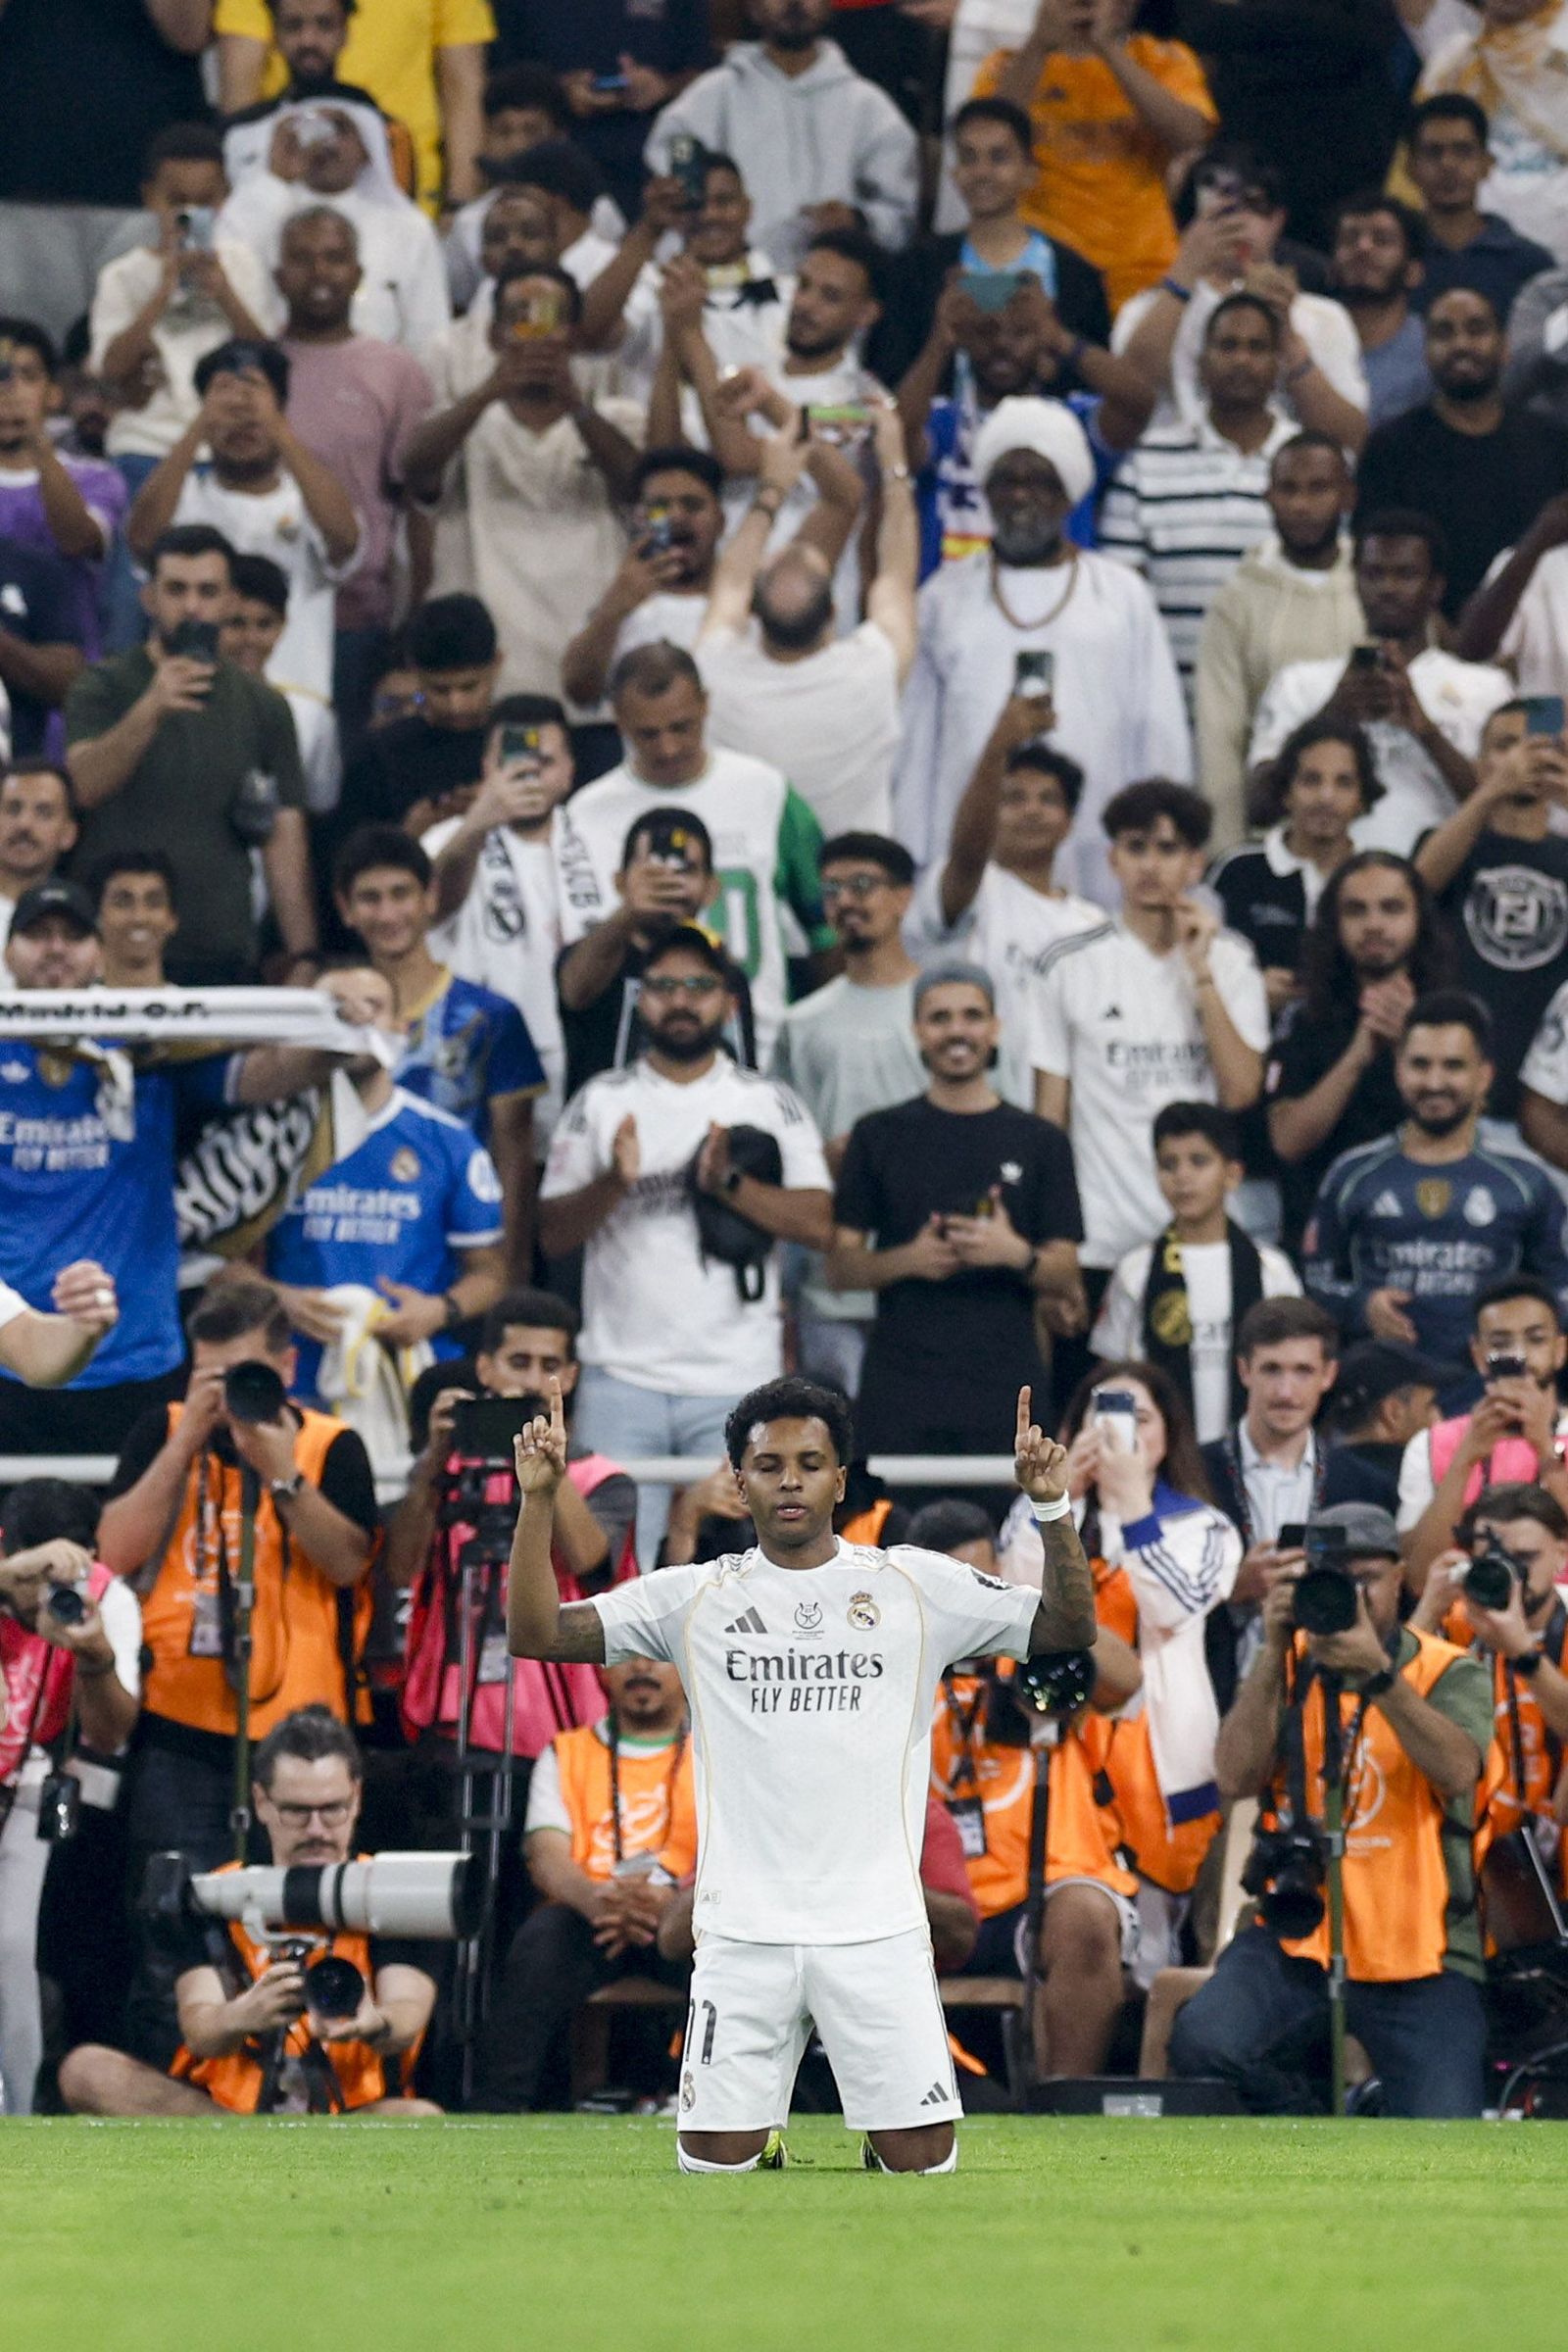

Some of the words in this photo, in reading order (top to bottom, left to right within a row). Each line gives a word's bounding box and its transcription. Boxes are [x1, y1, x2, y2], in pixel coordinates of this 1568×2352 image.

[725, 1647, 884, 1682] Emirates
[751, 1688, 782, 1713] FLY
[789, 1686, 861, 1712] BETTER
[685, 1998, 717, 2065] 11
